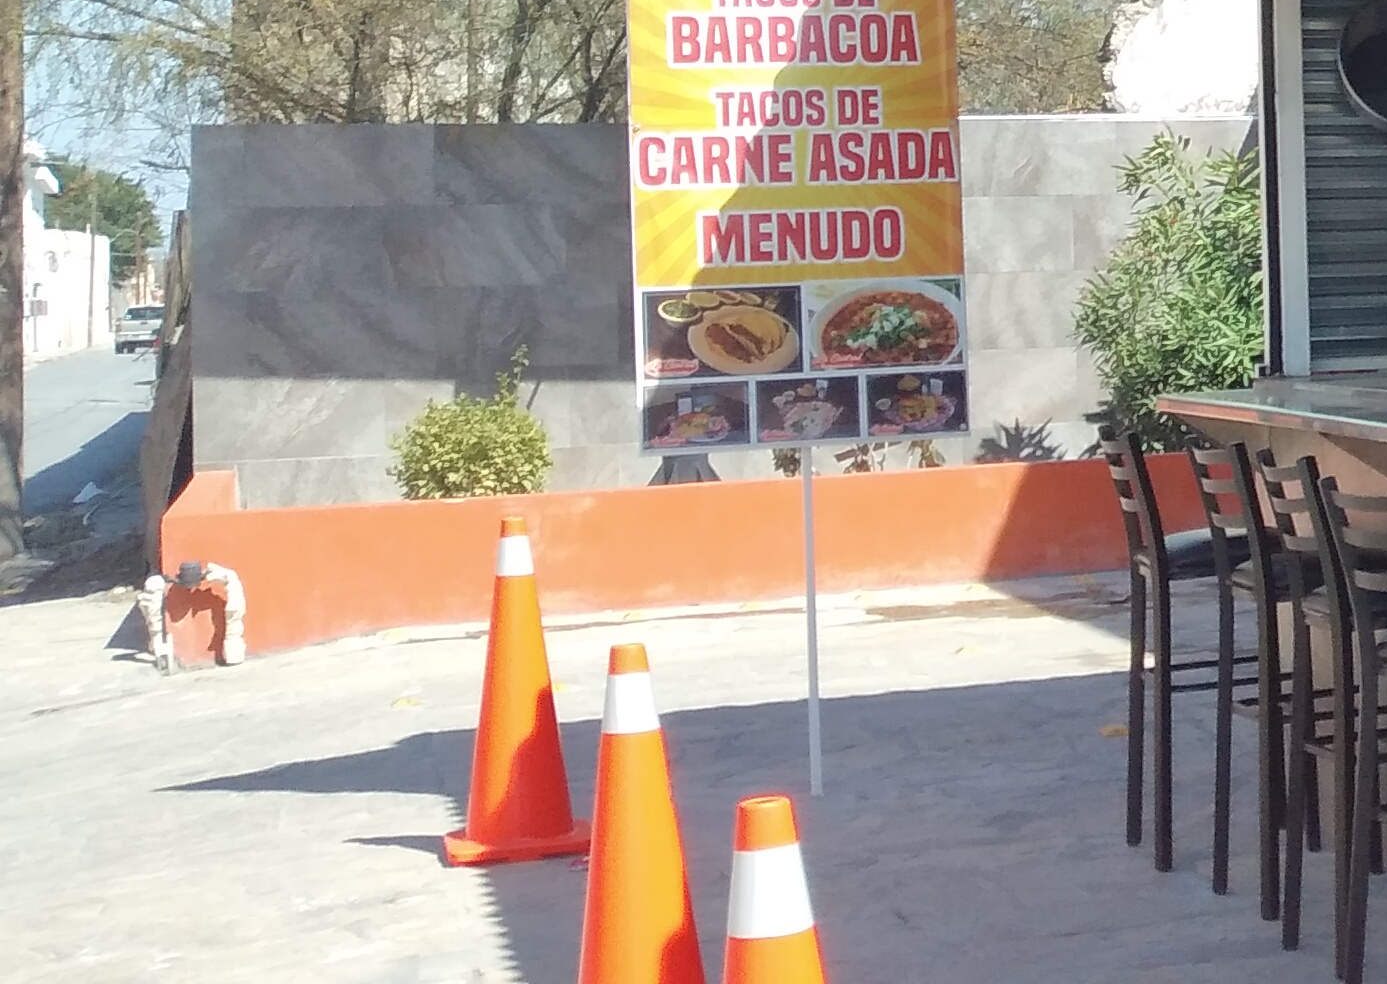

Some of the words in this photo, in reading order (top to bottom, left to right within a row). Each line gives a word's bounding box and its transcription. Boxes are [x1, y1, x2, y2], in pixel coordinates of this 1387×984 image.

[671, 14, 918, 64] BARBACOA
[715, 89, 826, 129] TACOS
[837, 88, 880, 127] DE
[638, 133, 793, 188] CARNE
[807, 130, 957, 184] ASADA
[703, 208, 902, 264] MENUDO
